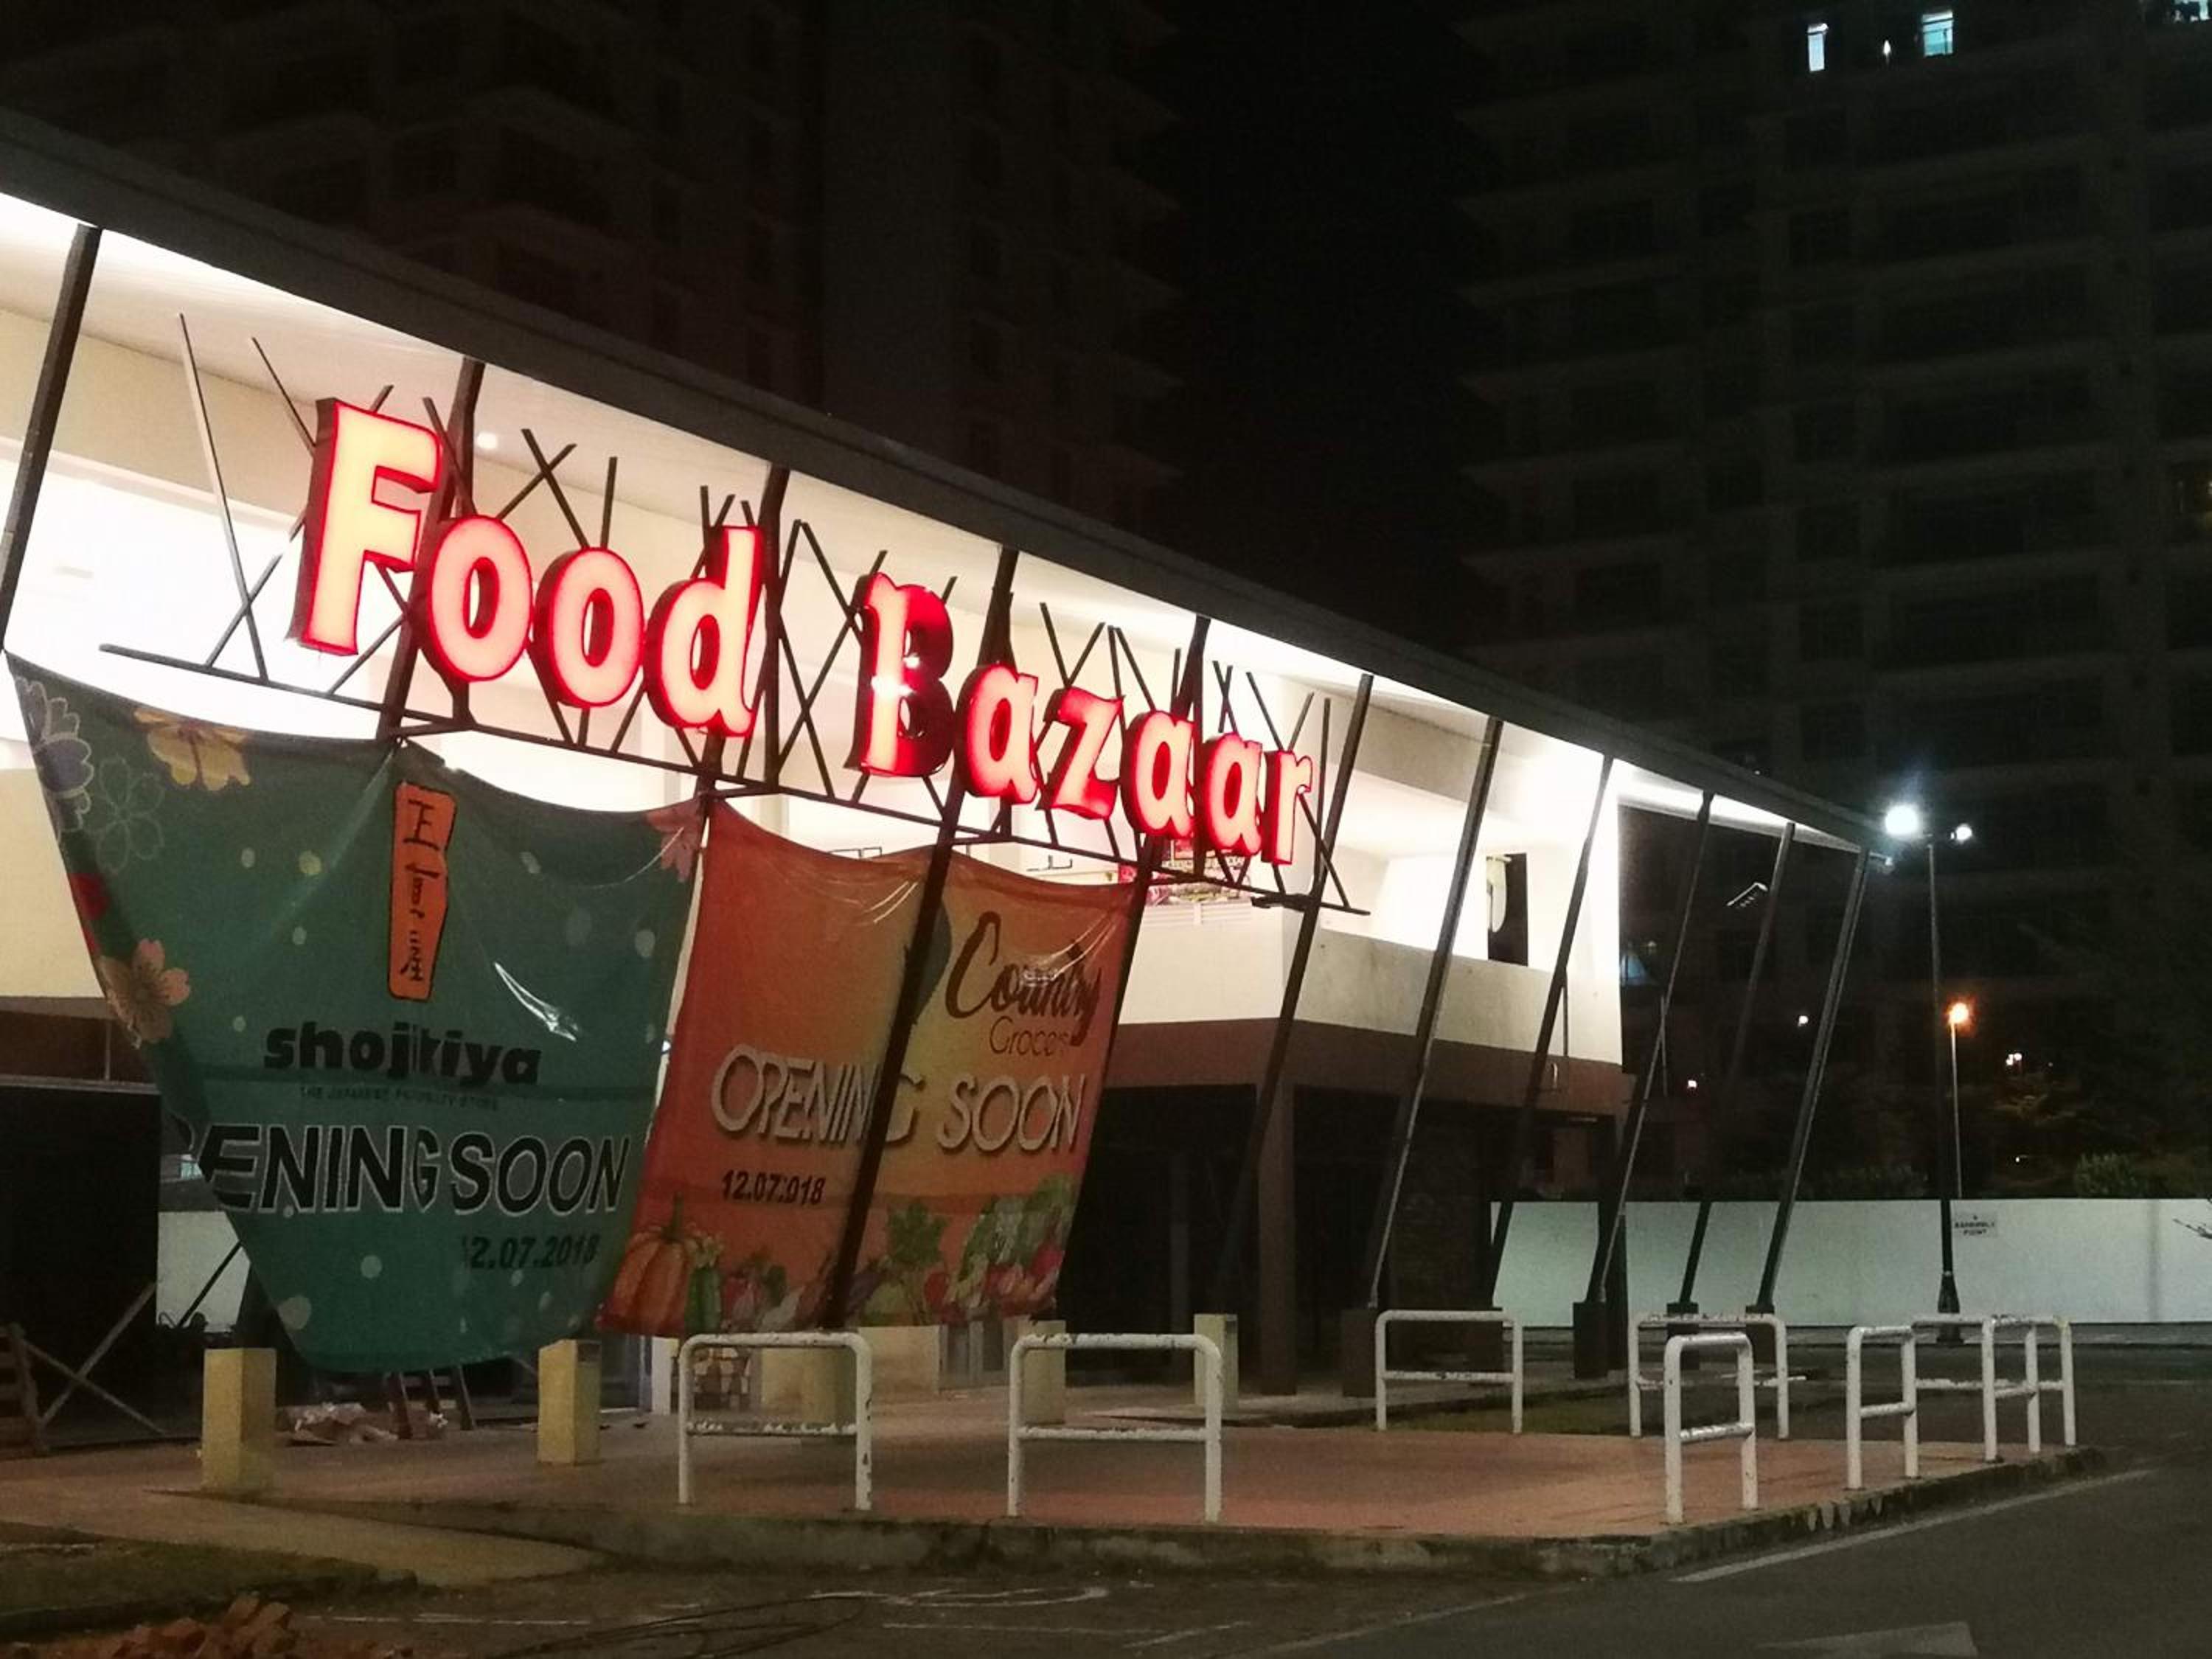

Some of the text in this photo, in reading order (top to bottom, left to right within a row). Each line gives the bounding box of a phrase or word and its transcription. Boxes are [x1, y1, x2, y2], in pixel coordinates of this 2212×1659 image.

[288, 399, 1312, 864] Food Bazaar
[945, 911, 1102, 1047] Country
[177, 1116, 630, 1217] ENING SOON
[936, 1073, 1087, 1153] SOON
